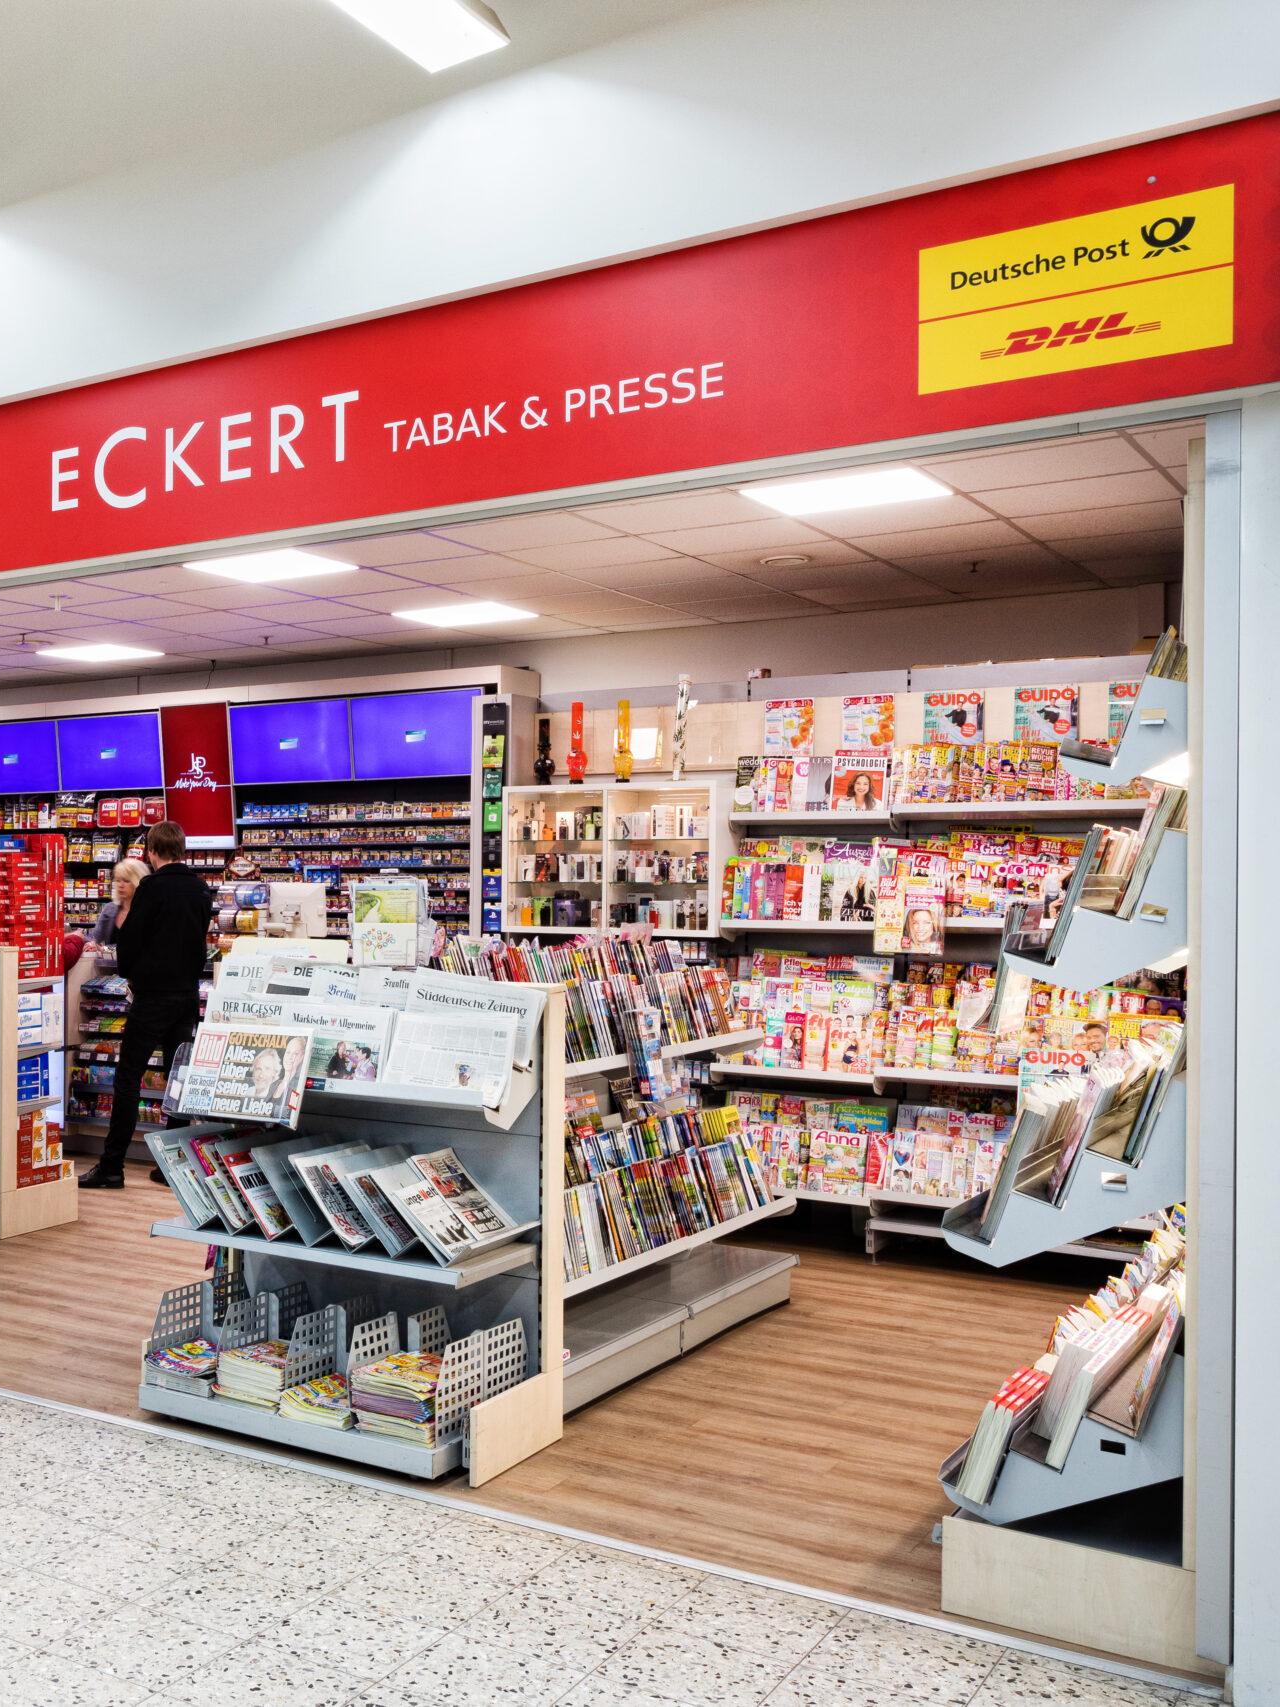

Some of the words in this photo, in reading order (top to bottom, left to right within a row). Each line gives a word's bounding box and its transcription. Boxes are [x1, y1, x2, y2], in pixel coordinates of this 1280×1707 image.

[950, 253, 1066, 291] Deutsche
[1073, 238, 1130, 266] Post
[1003, 312, 1135, 356] DHL
[50, 390, 359, 512] ECKERT
[383, 401, 507, 454] TABAK
[520, 395, 549, 431] &
[565, 362, 724, 422] PRESSE
[865, 695, 894, 704] Health
[927, 692, 981, 707] GUIDO
[1018, 687, 1075, 703] GUIDO
[788, 699, 813, 708] Health
[1031, 747, 1055, 756] REVUE
[203, 777, 217, 792] Day
[880, 878, 897, 887] Bild
[240, 965, 263, 978] DIE
[293, 966, 313, 977] DIE
[222, 1001, 240, 1013] DER
[416, 988, 487, 1010] Süddeutsche
[487, 999, 528, 1020] Zeitung
[293, 1013, 329, 1027] Märkische
[337, 1016, 376, 1032] Allgemeine
[229, 1032, 288, 1048] GOTTSCHALK
[225, 1046, 256, 1062] Alles
[1025, 1050, 1086, 1066] GUIDO
[221, 1063, 249, 1079] über
[216, 1078, 249, 1096] seine
[212, 1096, 240, 1113] neue
[242, 1098, 273, 1115] Liebe
[815, 1130, 860, 1147] Anna
